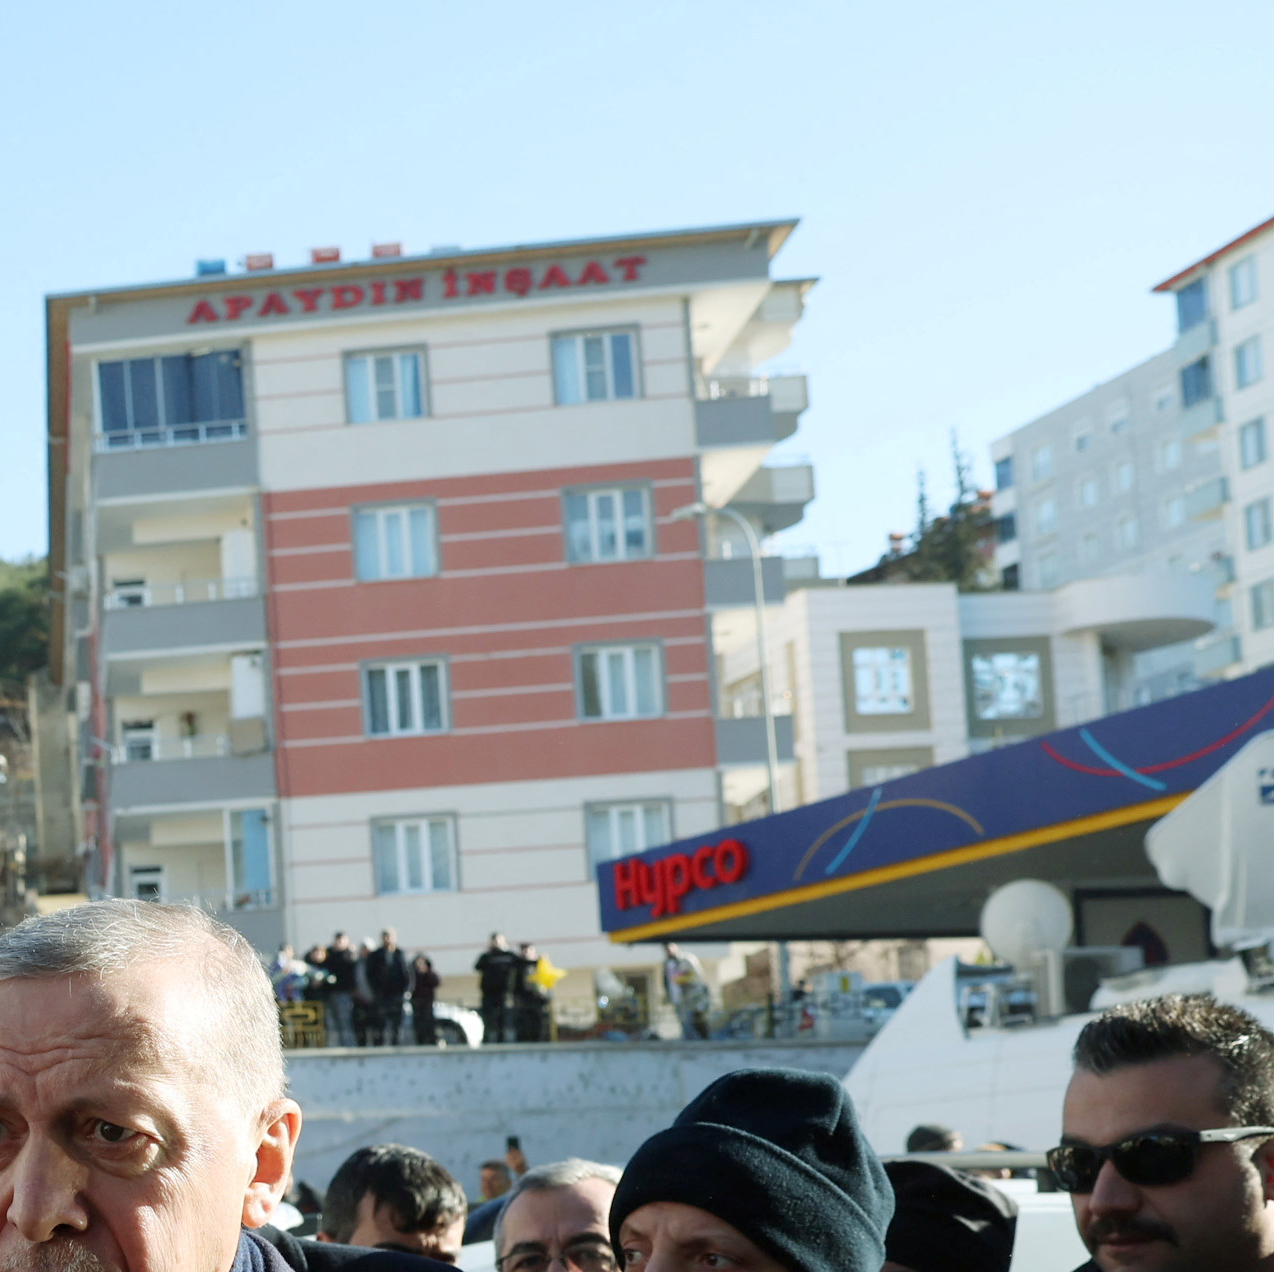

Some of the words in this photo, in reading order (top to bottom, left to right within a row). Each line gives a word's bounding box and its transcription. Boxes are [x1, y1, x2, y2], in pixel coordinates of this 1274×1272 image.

[187, 278, 425, 325] APAYDIN
[442, 255, 647, 299] İNŞAAT
[614, 838, 748, 918] Hypco
